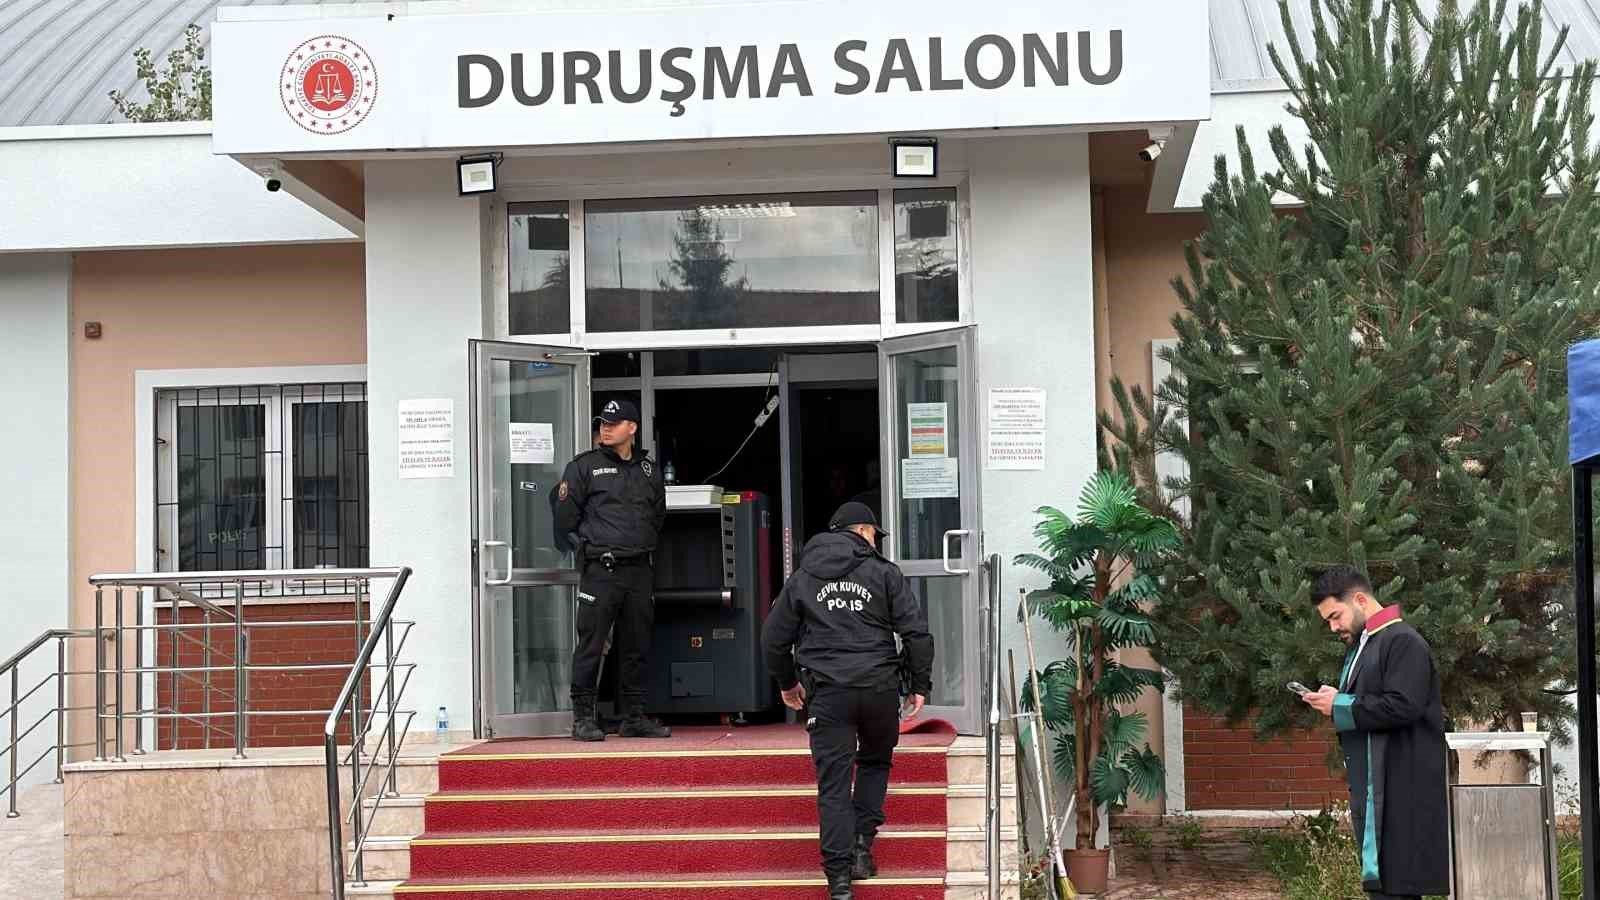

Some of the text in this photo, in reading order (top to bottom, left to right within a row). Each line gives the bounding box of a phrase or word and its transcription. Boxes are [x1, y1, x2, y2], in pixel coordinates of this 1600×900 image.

[457, 29, 1124, 117] DURUŞMA SALONU
[839, 581, 873, 603] KUVVET
[827, 597, 864, 612] POIS
